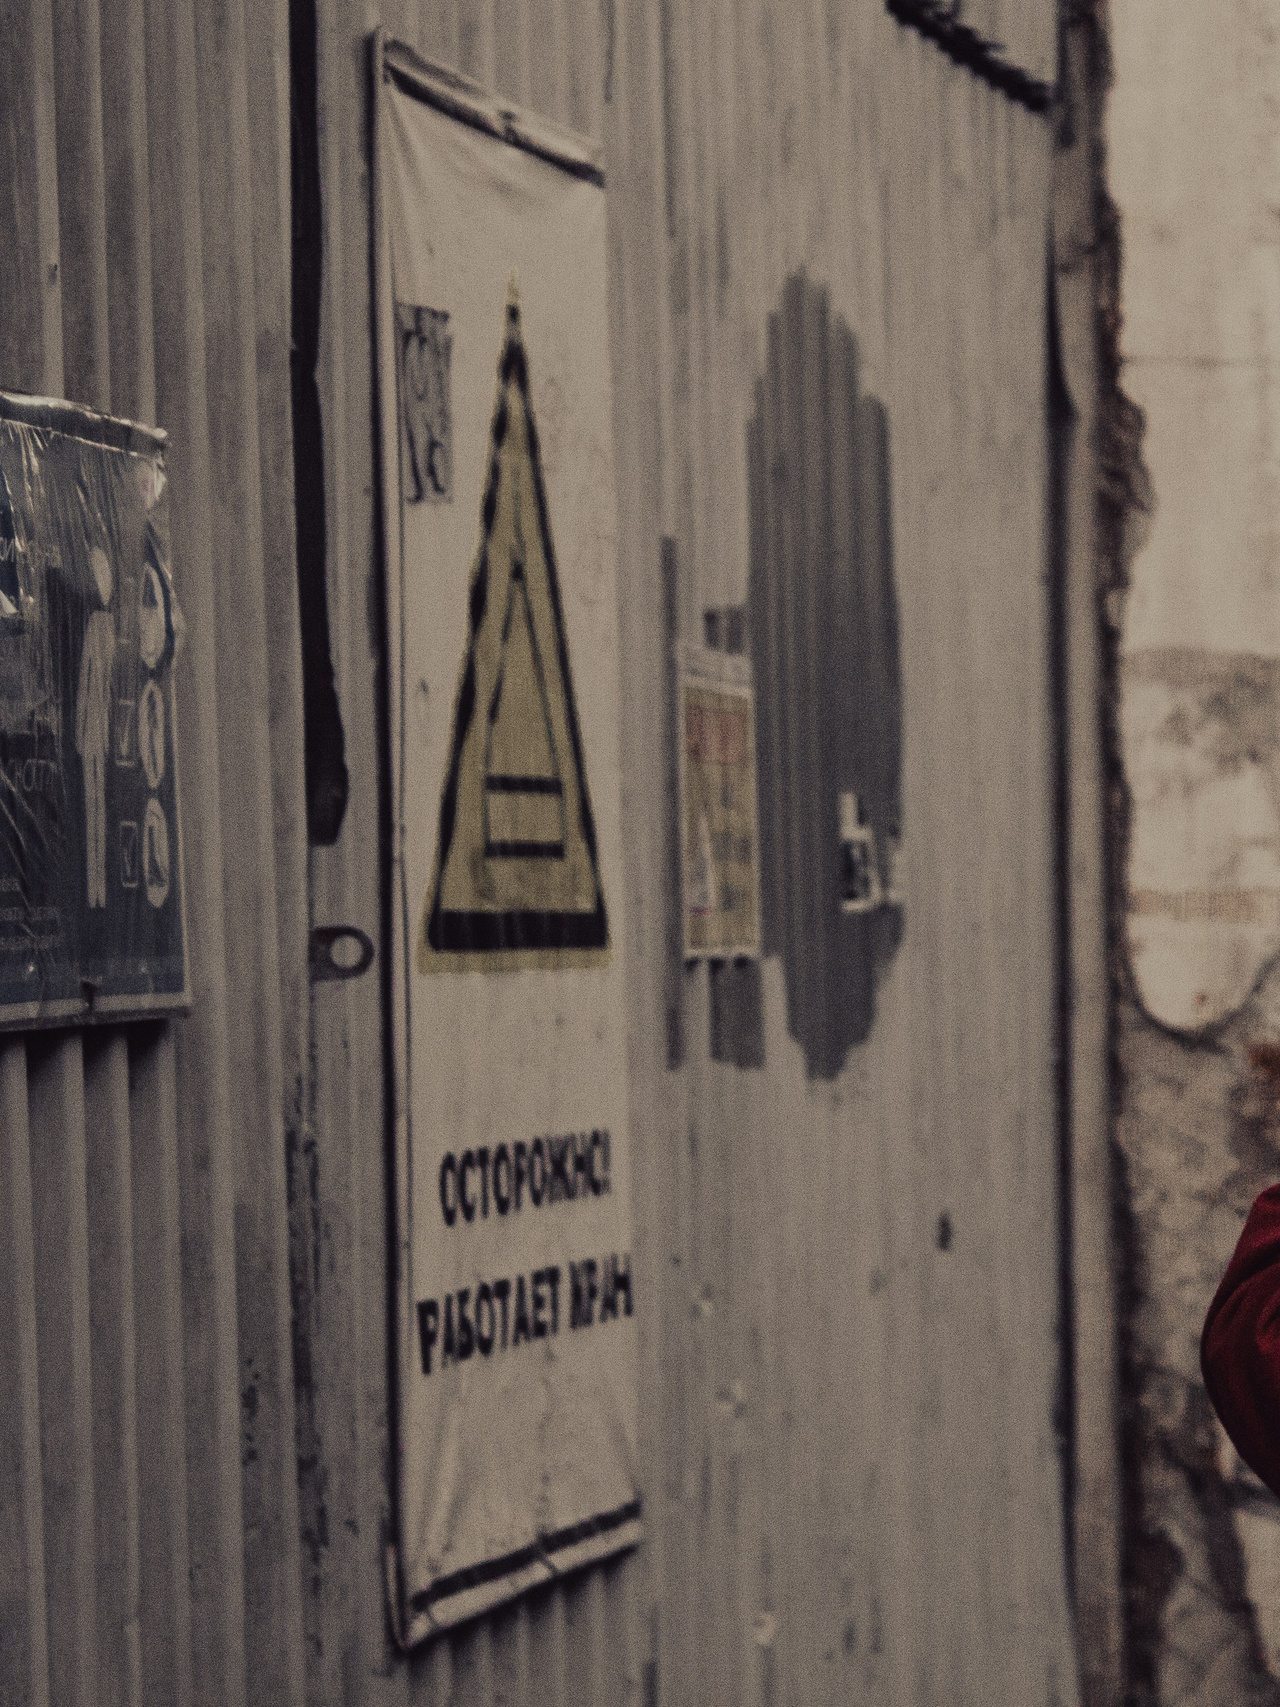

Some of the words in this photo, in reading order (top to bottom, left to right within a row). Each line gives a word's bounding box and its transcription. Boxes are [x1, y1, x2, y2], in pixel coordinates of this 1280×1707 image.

[439, 1129, 611, 1227] ОСТОРОЖНО!
[416, 1265, 560, 1377] РАБОТАЕТ
[569, 1253, 634, 1330] КРАН
